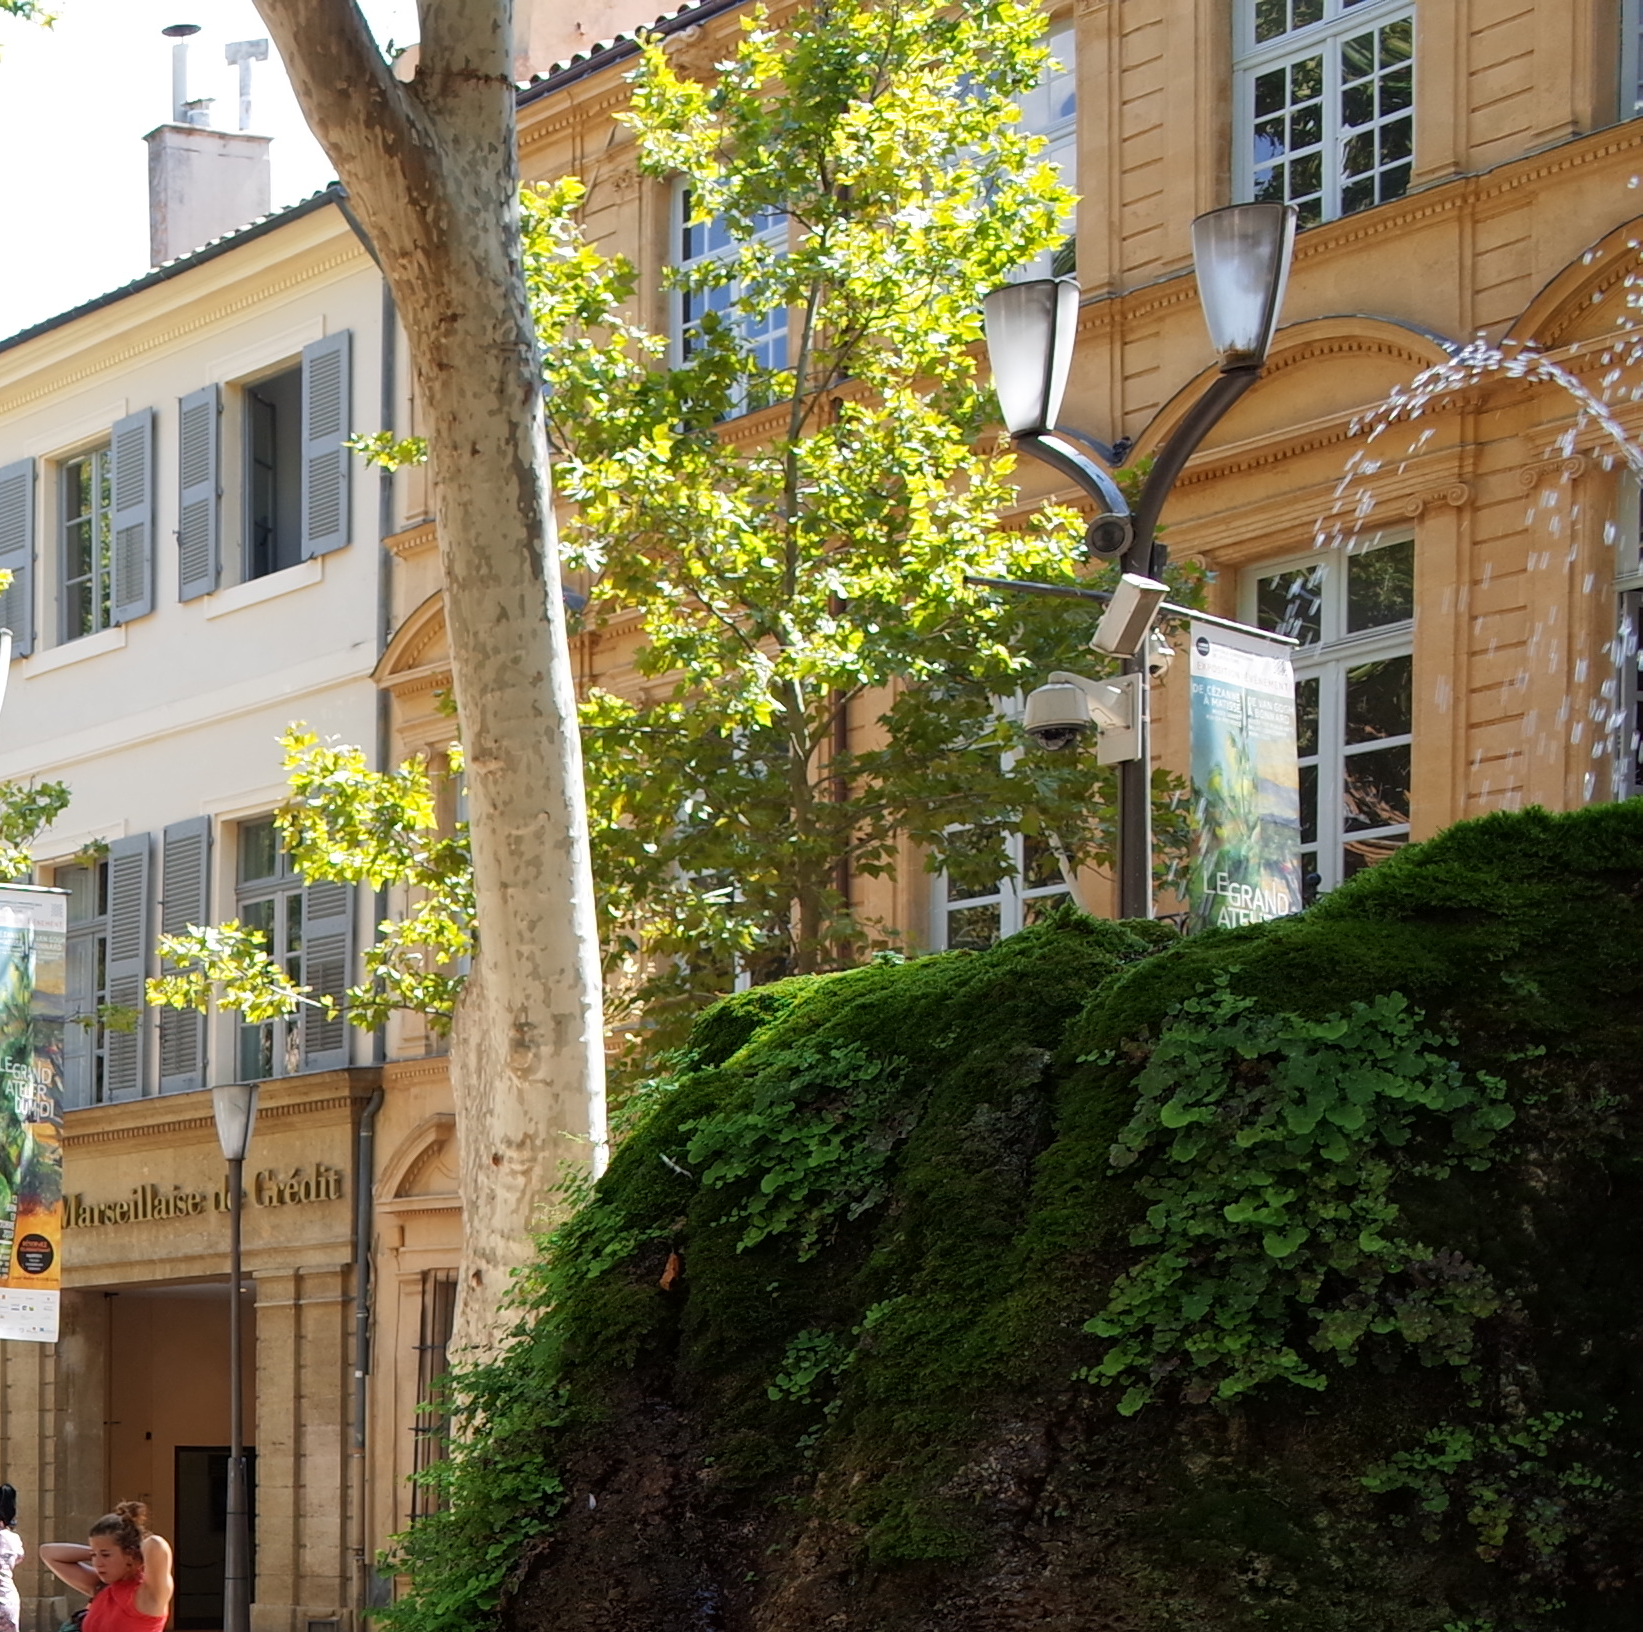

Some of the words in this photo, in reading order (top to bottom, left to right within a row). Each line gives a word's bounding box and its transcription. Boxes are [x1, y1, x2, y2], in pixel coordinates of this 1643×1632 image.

[1193, 683, 1204, 694] DE
[1203, 871, 1229, 896] LE
[1228, 882, 1289, 915] GRAND
[12, 1061, 52, 1084] GRAND
[5, 1079, 47, 1101] ATELIER
[15, 1096, 28, 1115] DU
[61, 1182, 203, 1230] Marseillaise
[254, 1163, 341, 1209] Crédit
